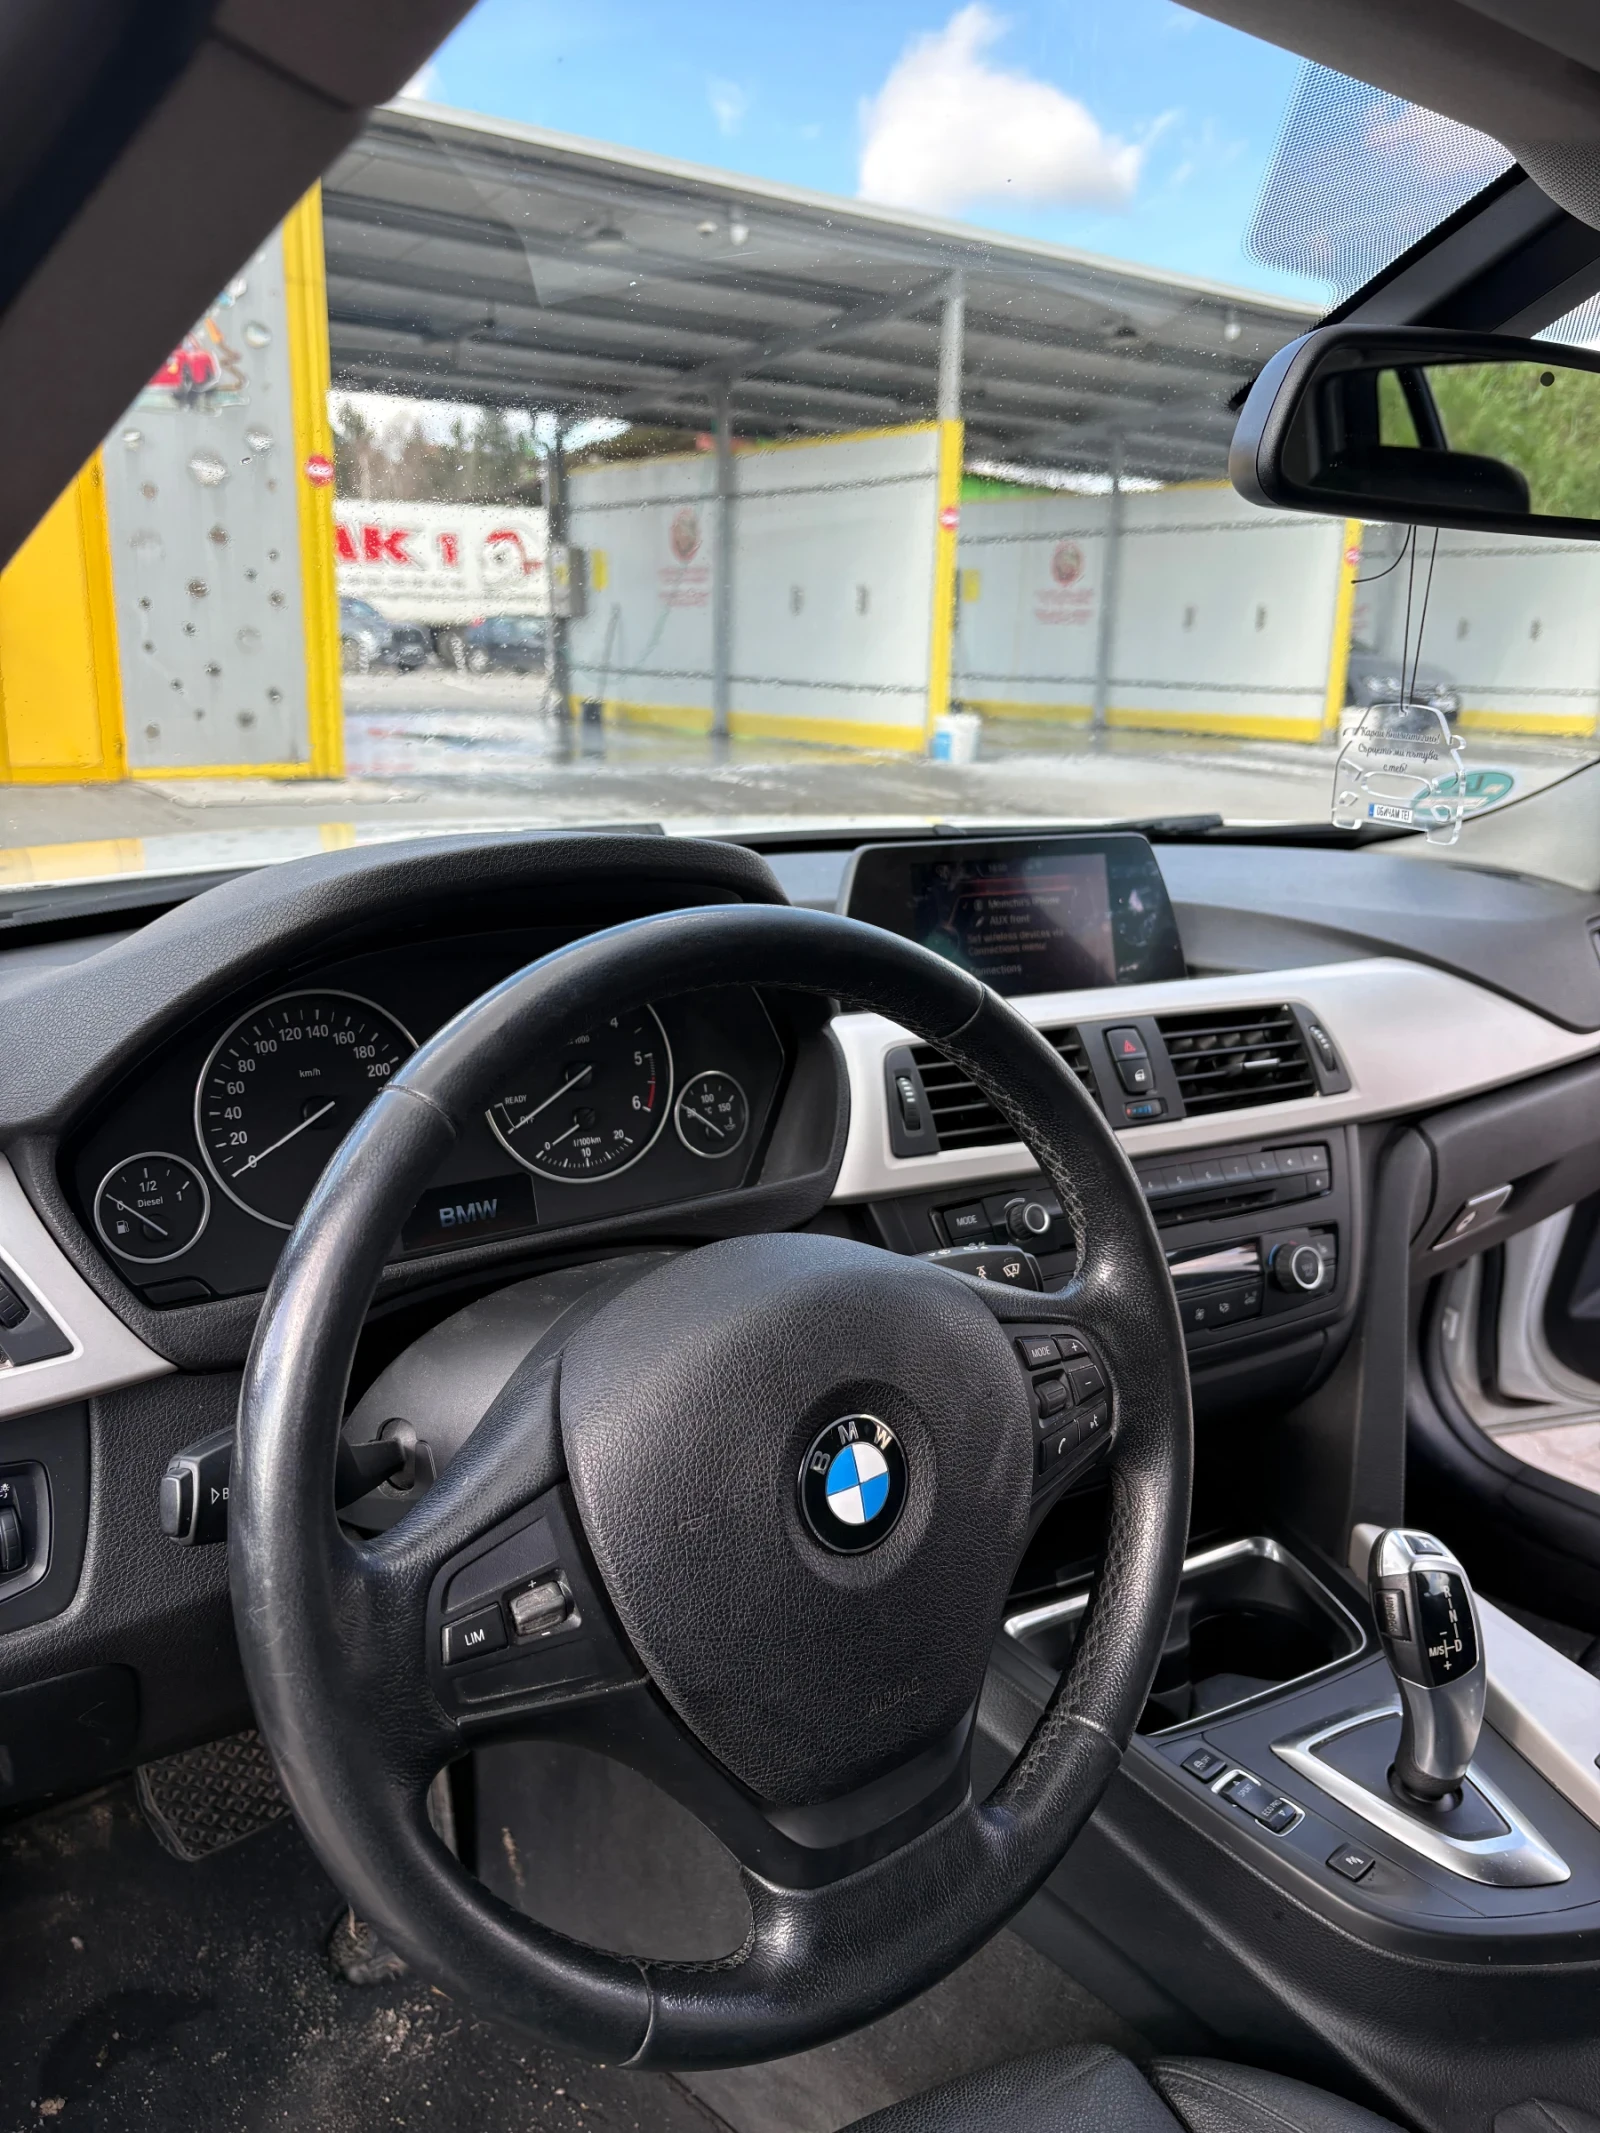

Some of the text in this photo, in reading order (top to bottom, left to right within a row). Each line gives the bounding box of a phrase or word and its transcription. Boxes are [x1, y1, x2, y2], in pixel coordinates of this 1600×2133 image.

[1406, 749, 1439, 764] пътува
[990, 914, 1031, 925] AUX front
[984, 931, 1018, 942] wireless
[1020, 930, 1050, 940] devices
[968, 945, 1020, 956] Connections
[970, 964, 1022, 976] Connections
[610, 1017, 619, 1028] 4
[279, 1028, 302, 1042] 120
[306, 1025, 329, 1039] 140
[333, 1031, 356, 1045] 160
[253, 1039, 277, 1054] 100
[353, 1045, 376, 1059] 180
[634, 1051, 643, 1065] 5
[238, 1059, 256, 1073] 80
[367, 1063, 391, 1077] 200
[299, 1068, 321, 1078] km/h
[227, 1081, 245, 1095] 60
[504, 1094, 527, 1105] READY
[632, 1096, 641, 1110] 6
[700, 1093, 715, 1104] 100
[224, 1106, 242, 1120] 40
[718, 1102, 731, 1112] 150
[230, 1131, 248, 1145] 20
[613, 1129, 625, 1140] 20
[544, 1141, 551, 1151] 0
[581, 1147, 592, 1158] 10
[247, 1155, 258, 1168] 0
[139, 1180, 158, 1193] 1/2
[137, 1196, 164, 1208] Diesel
[176, 1190, 183, 1201] 1
[439, 1198, 498, 1228] BMW
[956, 1214, 978, 1227] MODE
[1031, 1345, 1051, 1358] MODE
[810, 1421, 893, 1475] BMW
[1443, 1585, 1452, 1598] R
[1449, 1609, 1458, 1623] N
[464, 1628, 486, 1646] LIM
[1428, 1645, 1445, 1658] M/S
[1454, 1639, 1463, 1652] D
[1237, 1783, 1253, 1798] SPORT
[1262, 1799, 1283, 1817] ECO PRO
